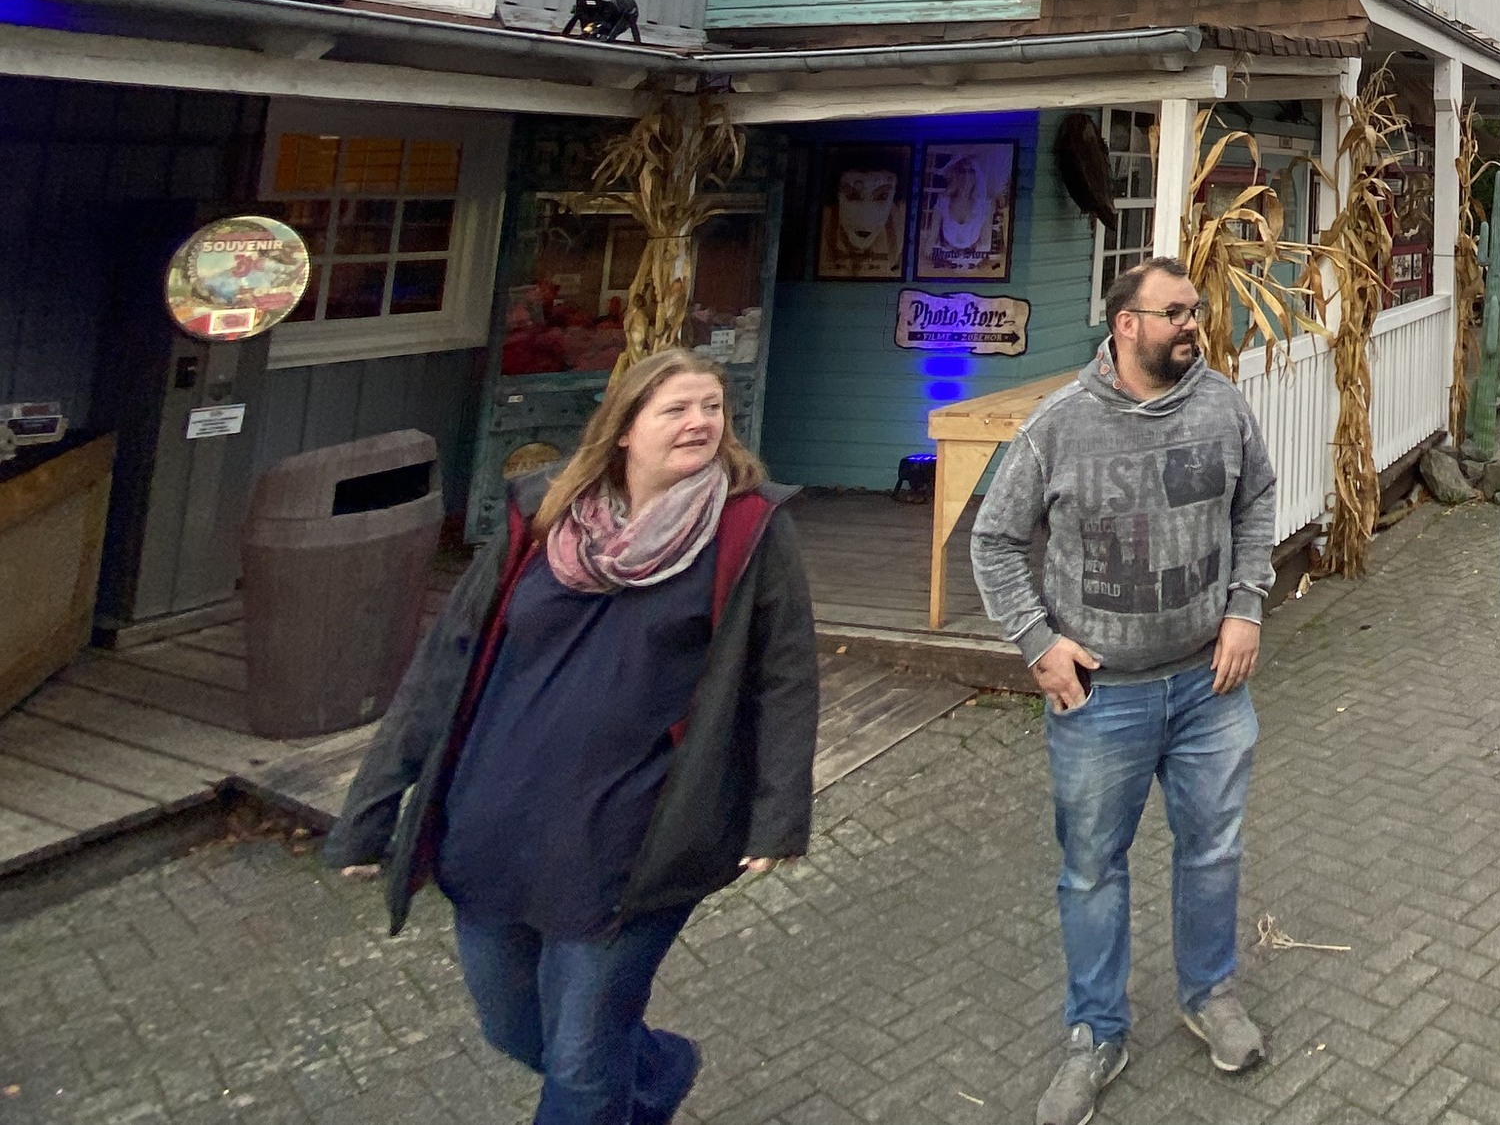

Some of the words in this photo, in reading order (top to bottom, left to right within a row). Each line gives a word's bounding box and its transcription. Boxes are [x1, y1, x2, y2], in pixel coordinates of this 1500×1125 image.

[202, 239, 283, 253] SOUVENIR
[908, 300, 958, 329] Photo
[956, 301, 1015, 328] Store
[1076, 453, 1165, 513] USA
